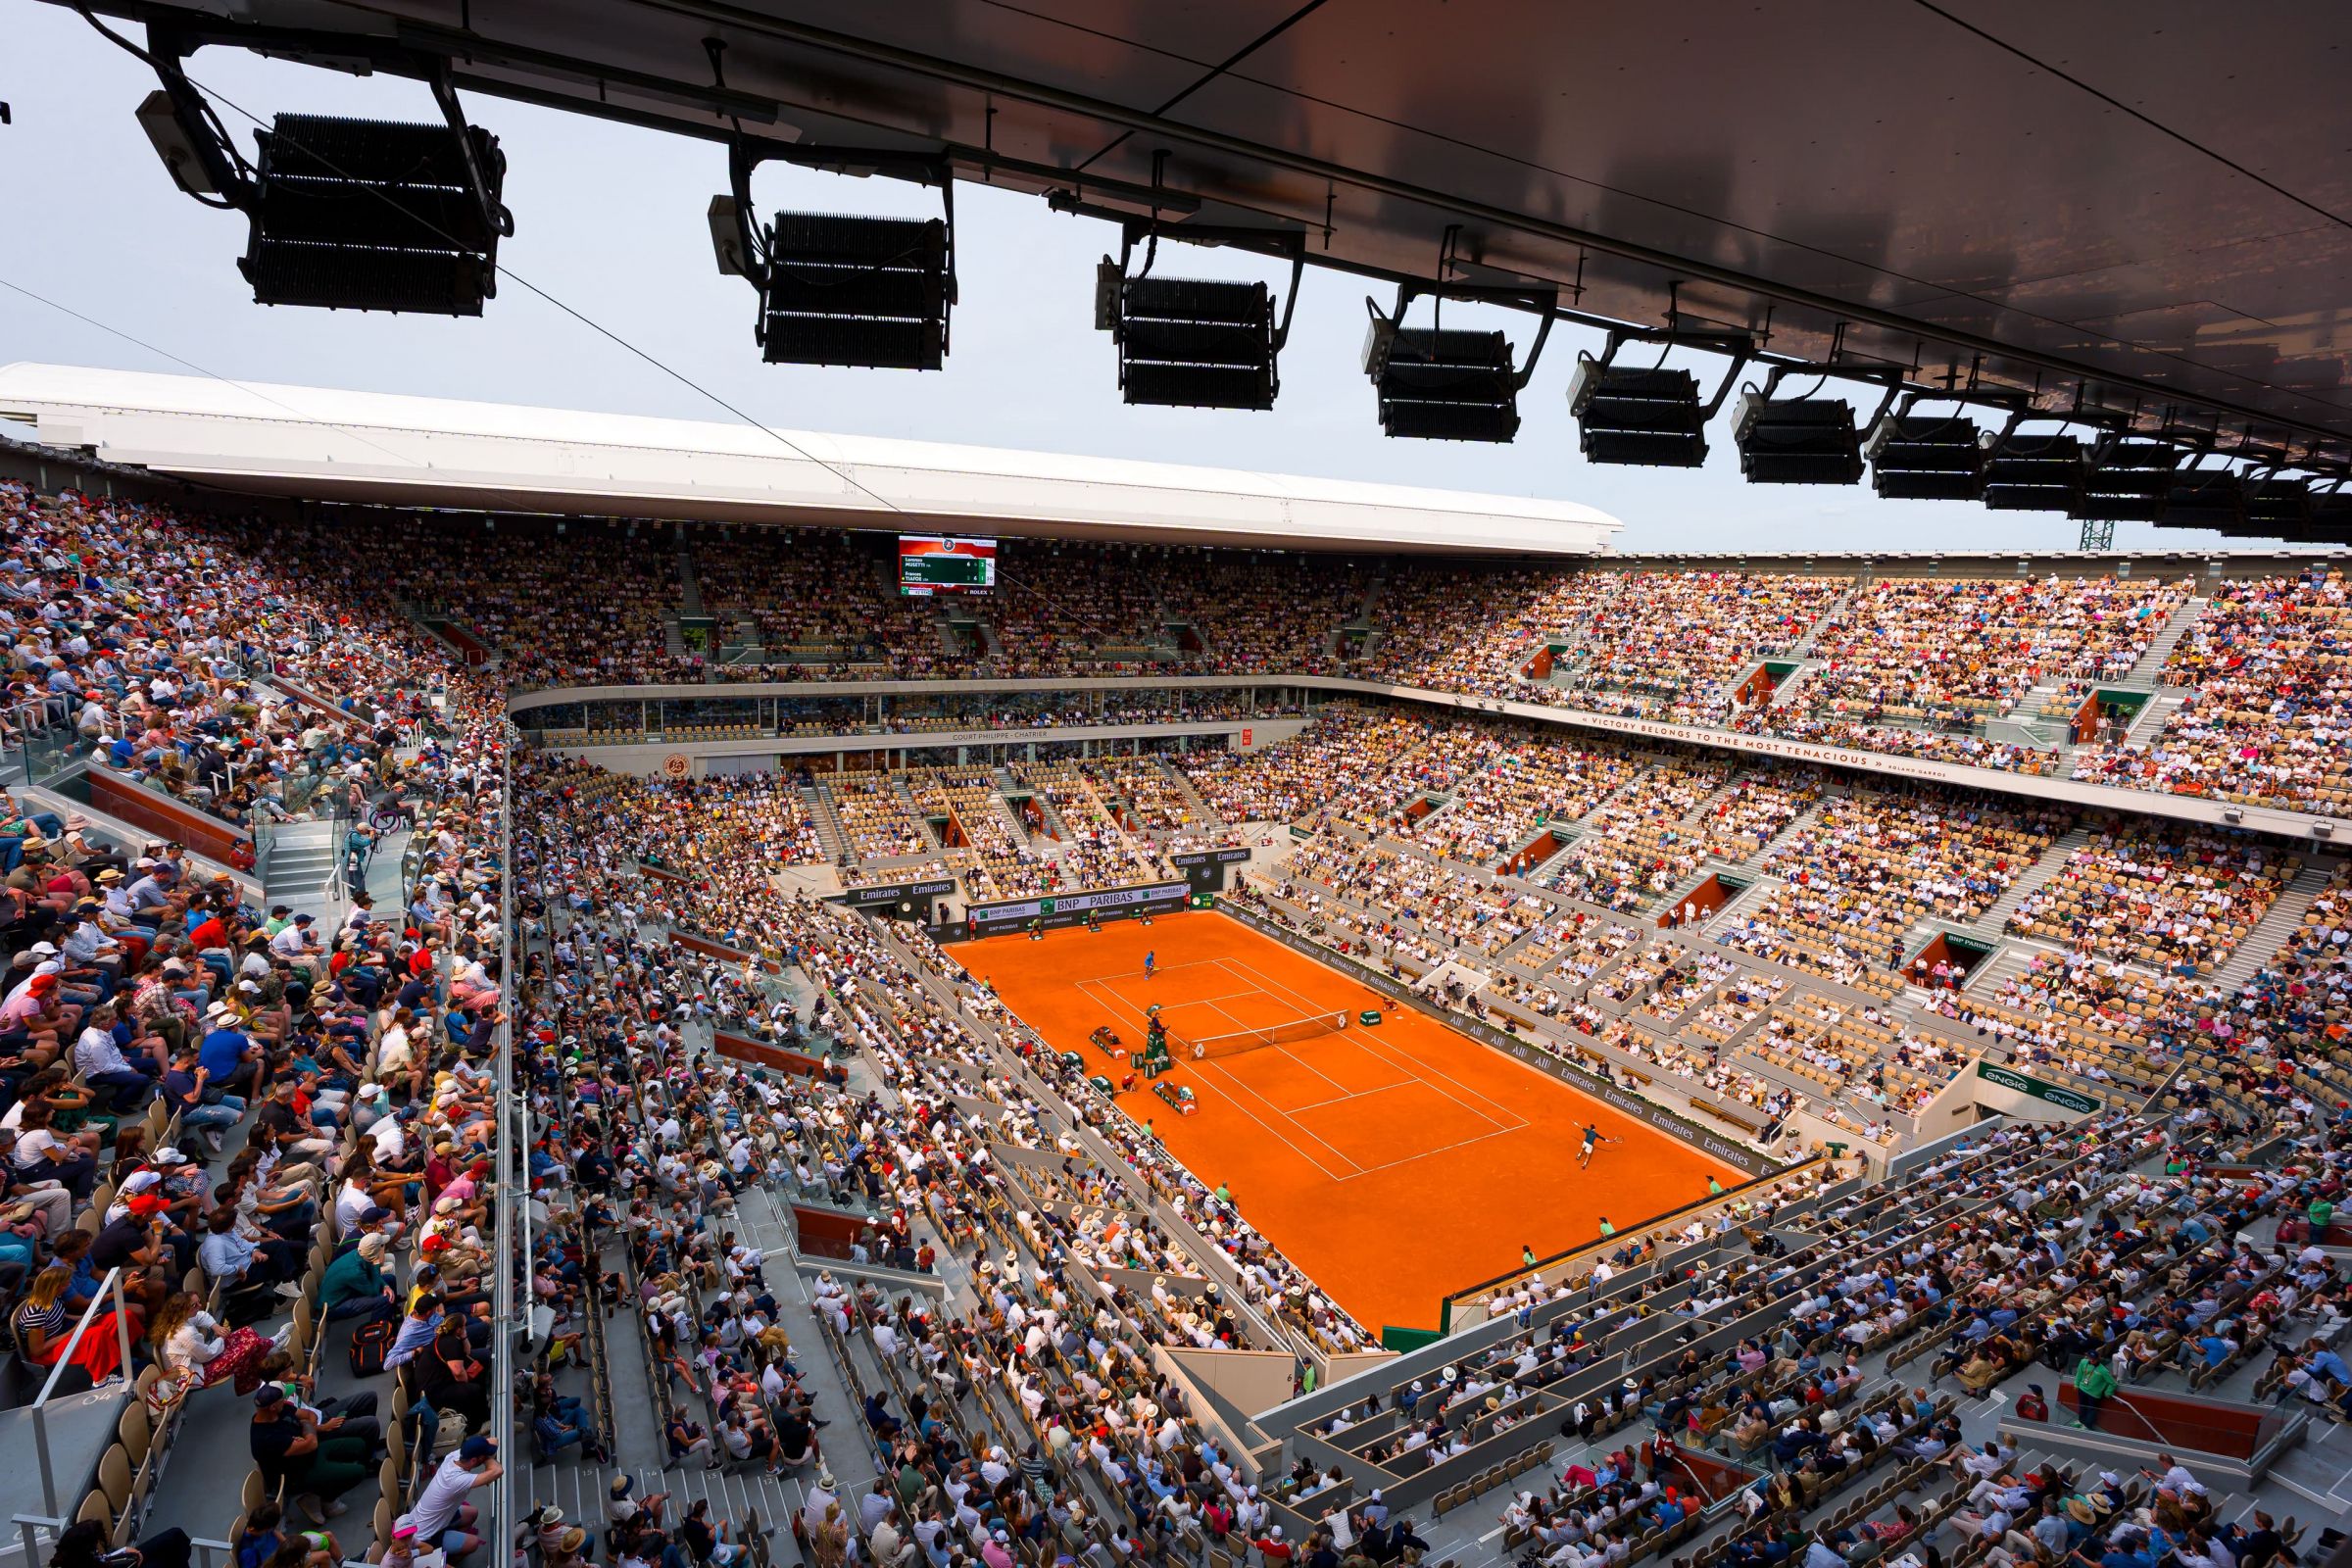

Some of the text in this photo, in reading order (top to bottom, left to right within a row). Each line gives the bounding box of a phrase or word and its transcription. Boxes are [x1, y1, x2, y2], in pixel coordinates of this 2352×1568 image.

[1592, 717, 1636, 730] VICTORY
[1642, 726, 1690, 738] BELONGS
[1717, 736, 1739, 746] THE
[1745, 741, 1780, 752] MOST
[1787, 746, 1868, 765] TENACIOUS
[1176, 851, 1247, 865] Emirates Emirates
[860, 882, 951, 900] Emirates Emirates
[1058, 893, 1133, 910] BNP PARIBAS
[1295, 939, 1318, 955] RENAULT
[1331, 956, 1357, 973] RENAULT
[1370, 976, 1399, 994] RENAULT
[1561, 1067, 1597, 1092] Emirates
[1605, 1089, 1643, 1114] Emirates
[1652, 1111, 1693, 1139] Emirates
[1704, 1137, 1748, 1166] Emirates
[81, 1393, 112, 1405] 04
